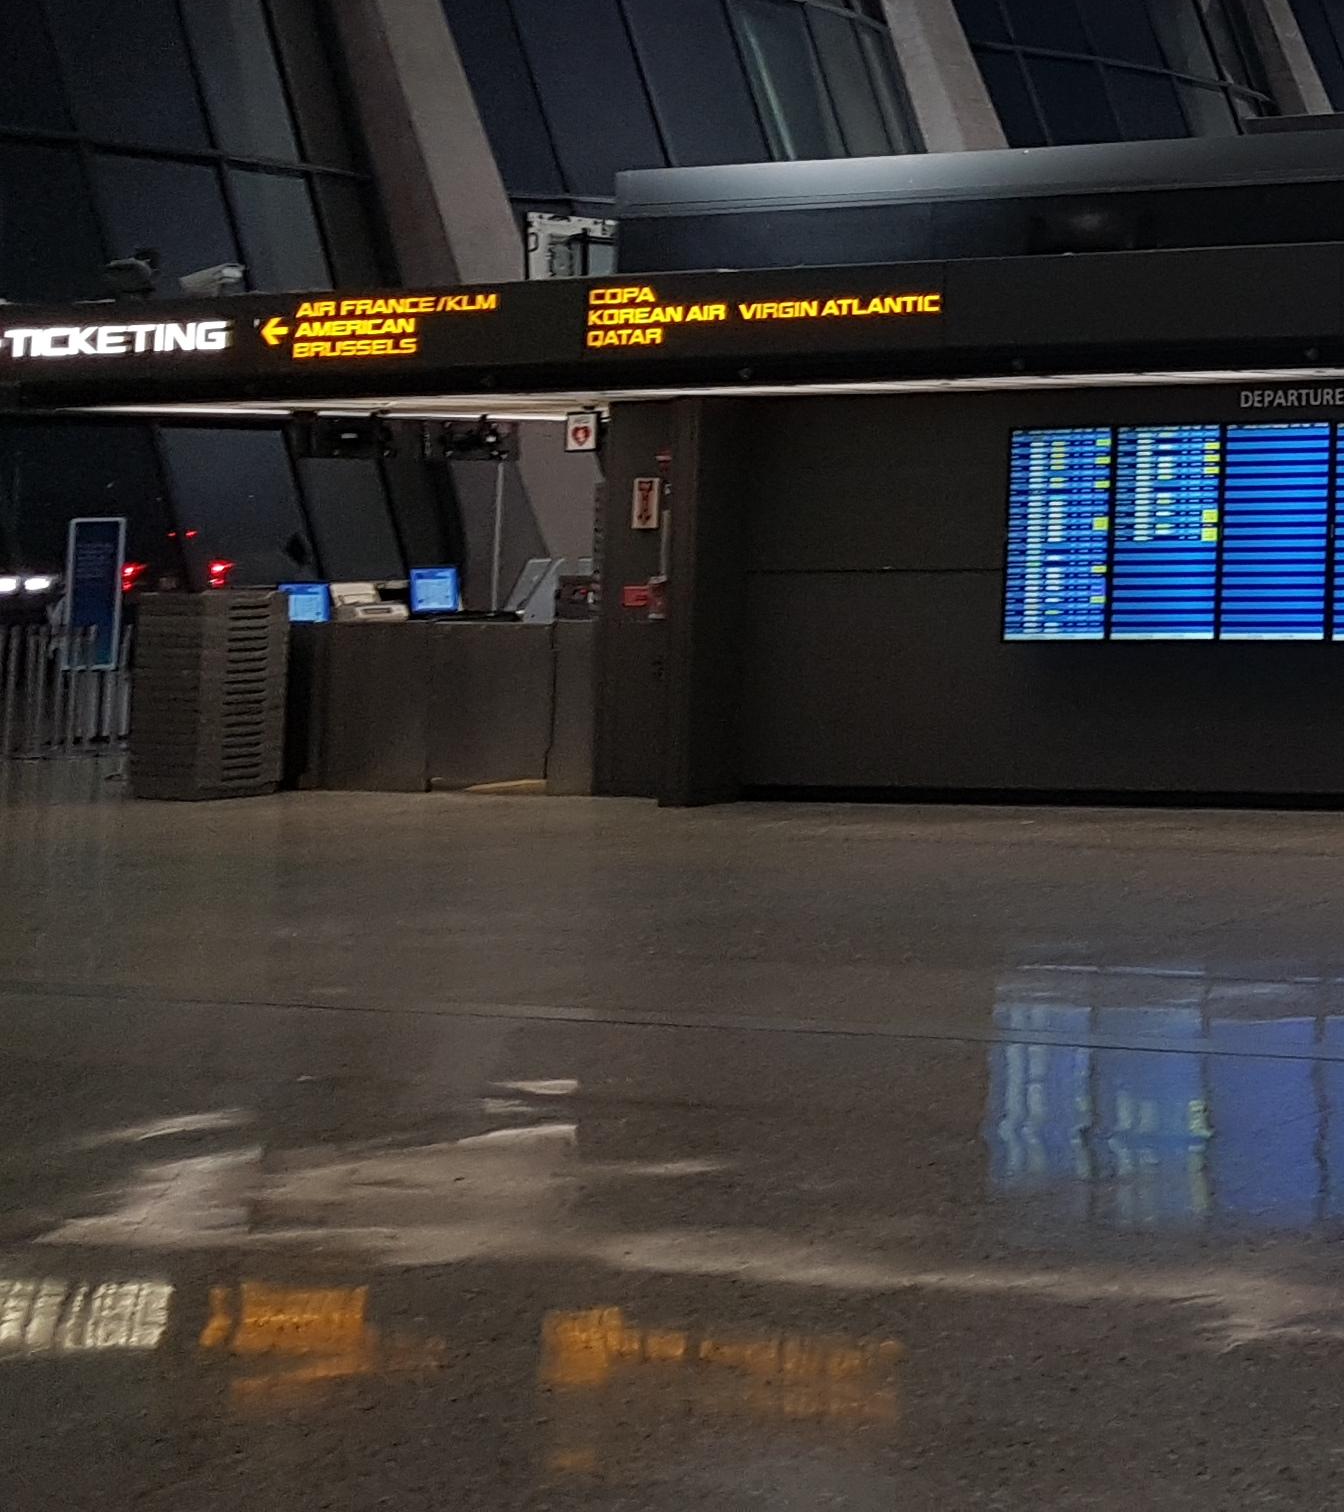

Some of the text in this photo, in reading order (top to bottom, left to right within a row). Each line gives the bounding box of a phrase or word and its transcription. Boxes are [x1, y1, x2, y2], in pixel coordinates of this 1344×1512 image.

[295, 293, 498, 318] AIR FRANCE/KLM
[588, 287, 656, 306] COPA
[587, 294, 941, 326] KOREAN AIR VIRGIN ATLANTIC
[294, 317, 416, 338] AMERICAN
[586, 328, 663, 348] QATAR
[4, 320, 228, 358] TICKETING
[292, 338, 418, 359] BRUSSELS
